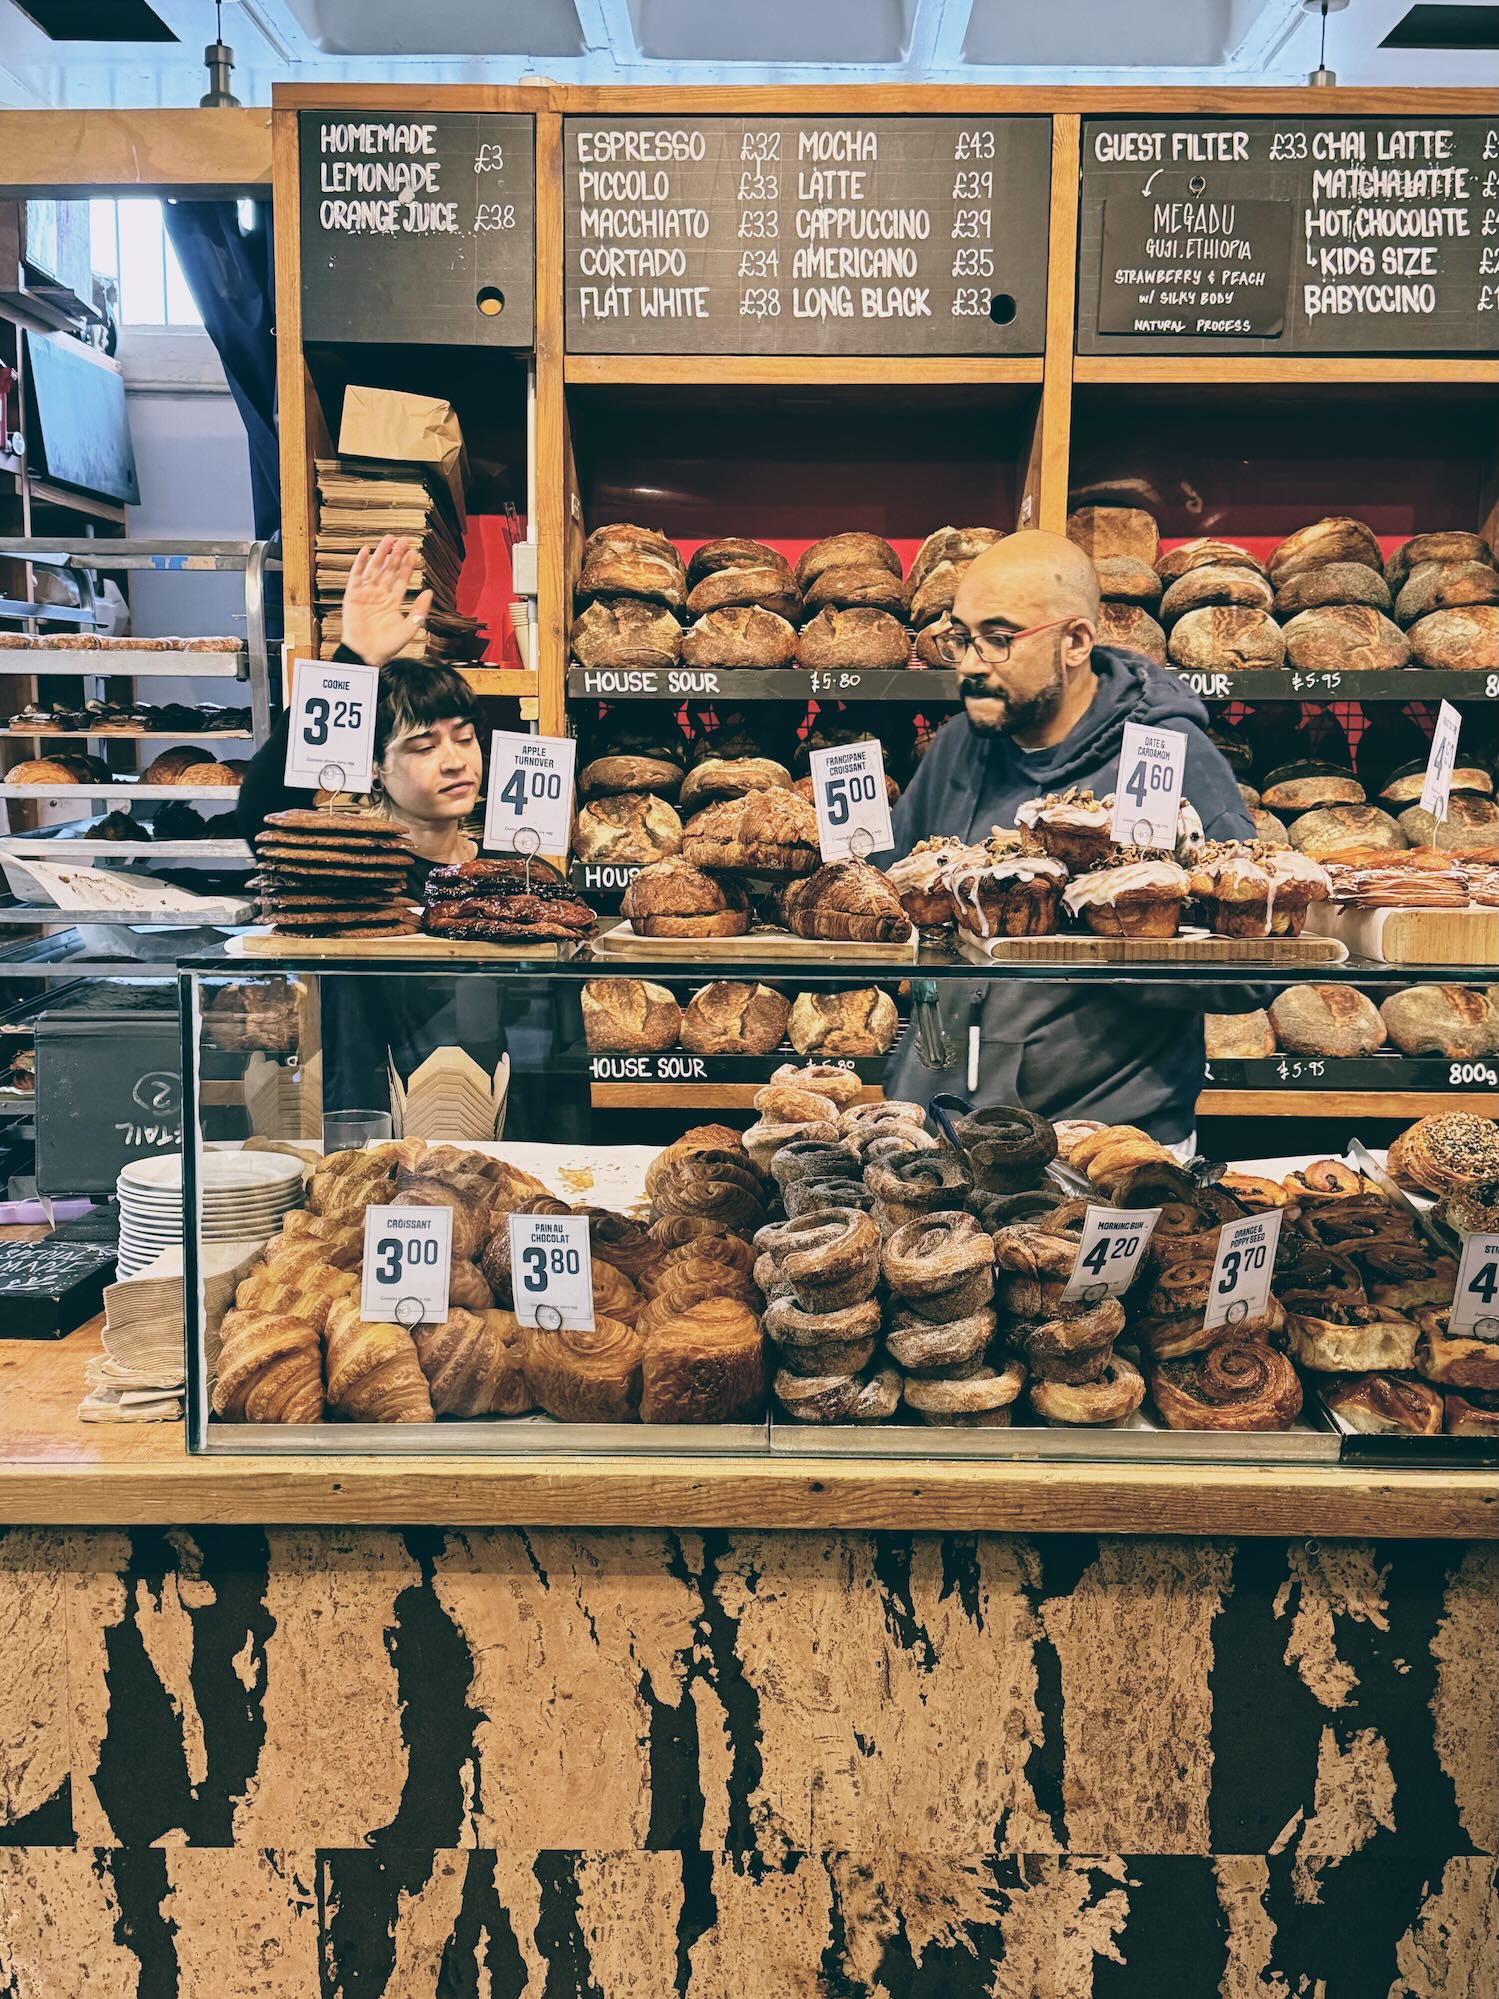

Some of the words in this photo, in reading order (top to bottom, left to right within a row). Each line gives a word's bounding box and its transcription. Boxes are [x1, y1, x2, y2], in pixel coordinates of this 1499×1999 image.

[320, 123, 437, 154] HOMEMADE
[577, 130, 706, 162] ESPRESSO
[798, 131, 878, 161] MOCHA
[1094, 132, 1166, 162] GUEST
[1172, 132, 1250, 161] FILTER
[1312, 131, 1366, 161] CHAI
[1377, 130, 1453, 161] LATTE
[474, 144, 503, 173] £3
[320, 162, 441, 193] LEMONADE
[578, 170, 669, 202] PICCOLO
[798, 171, 867, 201] LATTE
[319, 200, 400, 231] ORANGE
[402, 202, 459, 232] JUICE
[580, 208, 710, 239] MACCHIATO
[795, 208, 931, 240] CAPPUCCINO
[1153, 203, 1235, 235] MEGADU
[1305, 208, 1351, 238] HOT
[1356, 208, 1471, 238] CHOCOLATE
[579, 248, 686, 277] CORTADO
[792, 247, 918, 279] AMERICANO
[1320, 247, 1375, 276] KIDS
[1382, 247, 1438, 276] SIZE
[1114, 269, 1201, 286] STRAWBERRY
[1207, 270, 1216, 285] &
[1221, 271, 1265, 286] PEACH
[580, 287, 632, 318] FLAT
[640, 287, 710, 318] WHITE
[792, 286, 854, 317] LONG
[861, 286, 932, 318] BLACK
[1159, 291, 1196, 305] SILKY
[1200, 291, 1235, 306] BODY
[1304, 284, 1436, 314] BABYCCINO
[1134, 319, 1186, 333] NATURAL
[1196, 319, 1251, 333] PROCESS
[322, 679, 351, 691] COOKIE
[584, 671, 658, 693] HOUSE
[668, 671, 720, 694] SOUR
[514, 755, 554, 769] TURNOVER
[522, 745, 547, 757] APPLE
[829, 761, 866, 776] CROISSANT
[657, 1058, 707, 1079] SOUR
[1449, 1063, 1498, 1086] 800g
[387, 1219, 432, 1229] CROISSANT
[531, 1234, 570, 1244] CHOCOLAT
[535, 1223, 553, 1233] PAIN
[553, 1224, 564, 1233] AU
